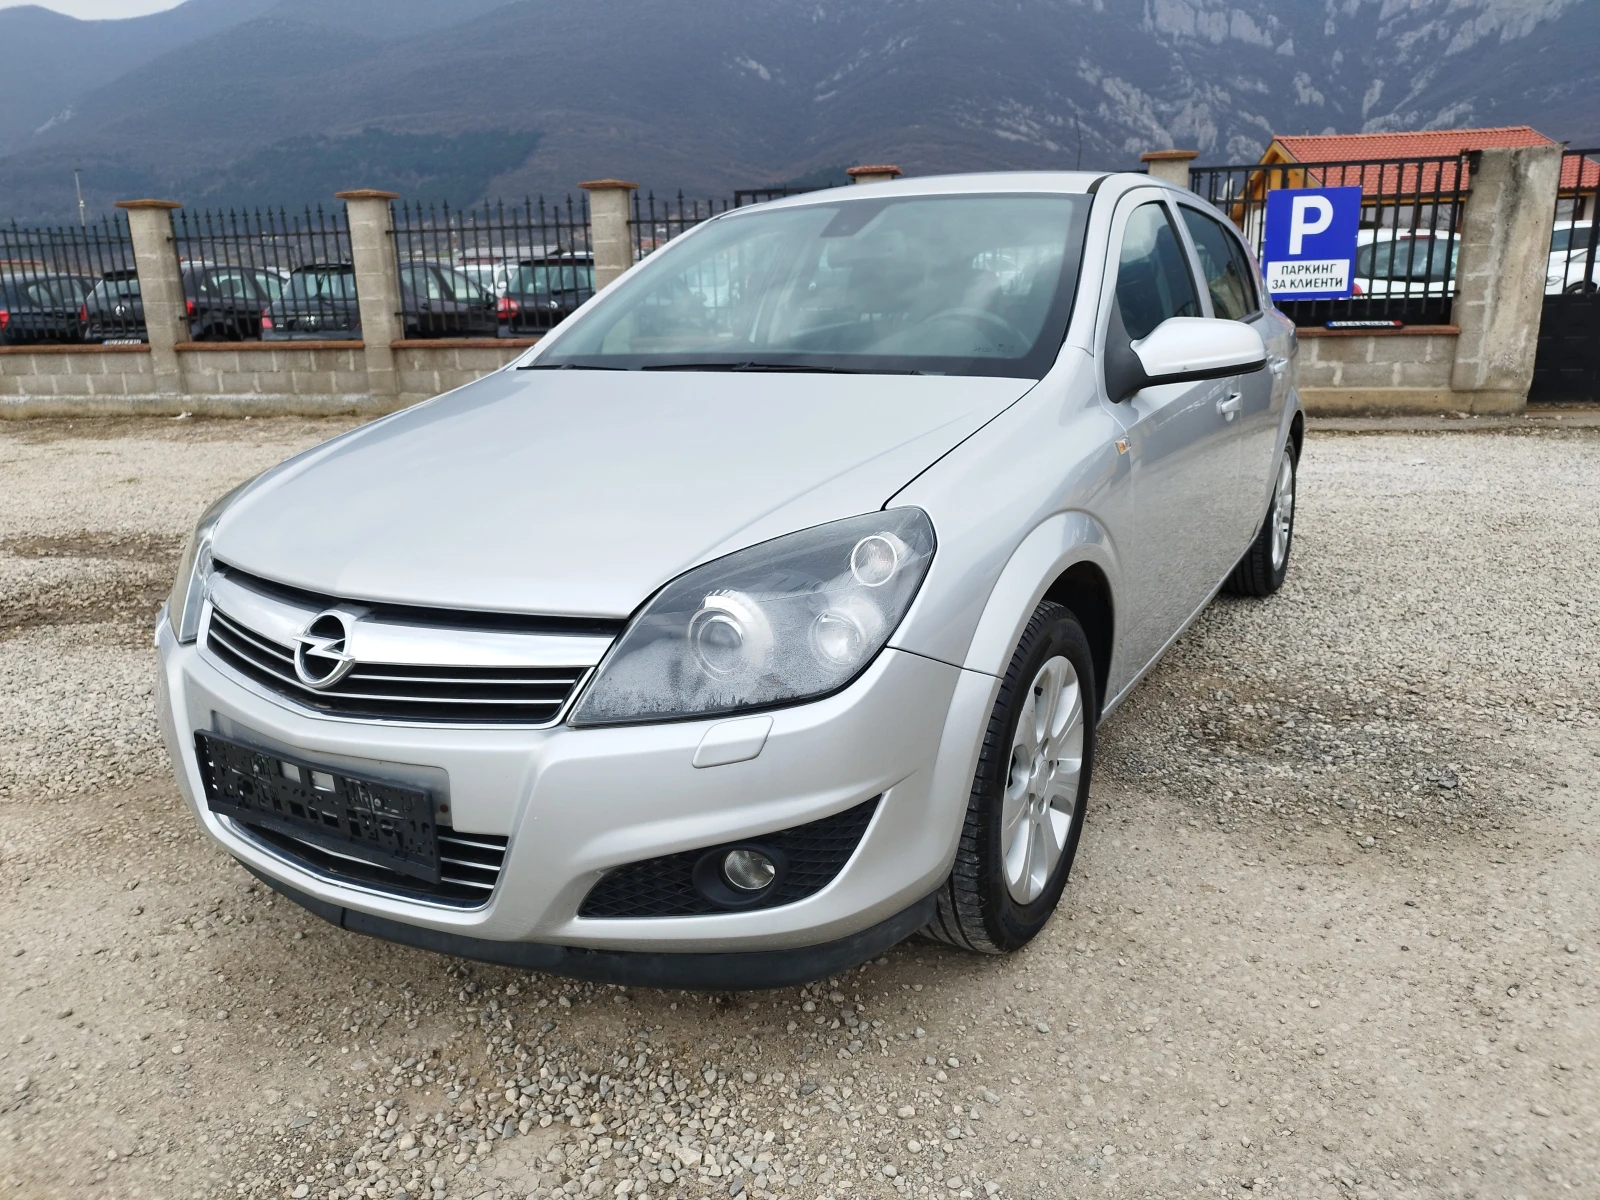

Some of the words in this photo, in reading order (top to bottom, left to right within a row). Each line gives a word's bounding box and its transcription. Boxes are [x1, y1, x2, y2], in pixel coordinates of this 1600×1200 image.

[1289, 195, 1334, 255] P
[1281, 264, 1336, 276] ПАРКИНГ
[1271, 279, 1286, 290] ЗА
[1290, 277, 1343, 289] КЛИЕНТИ
